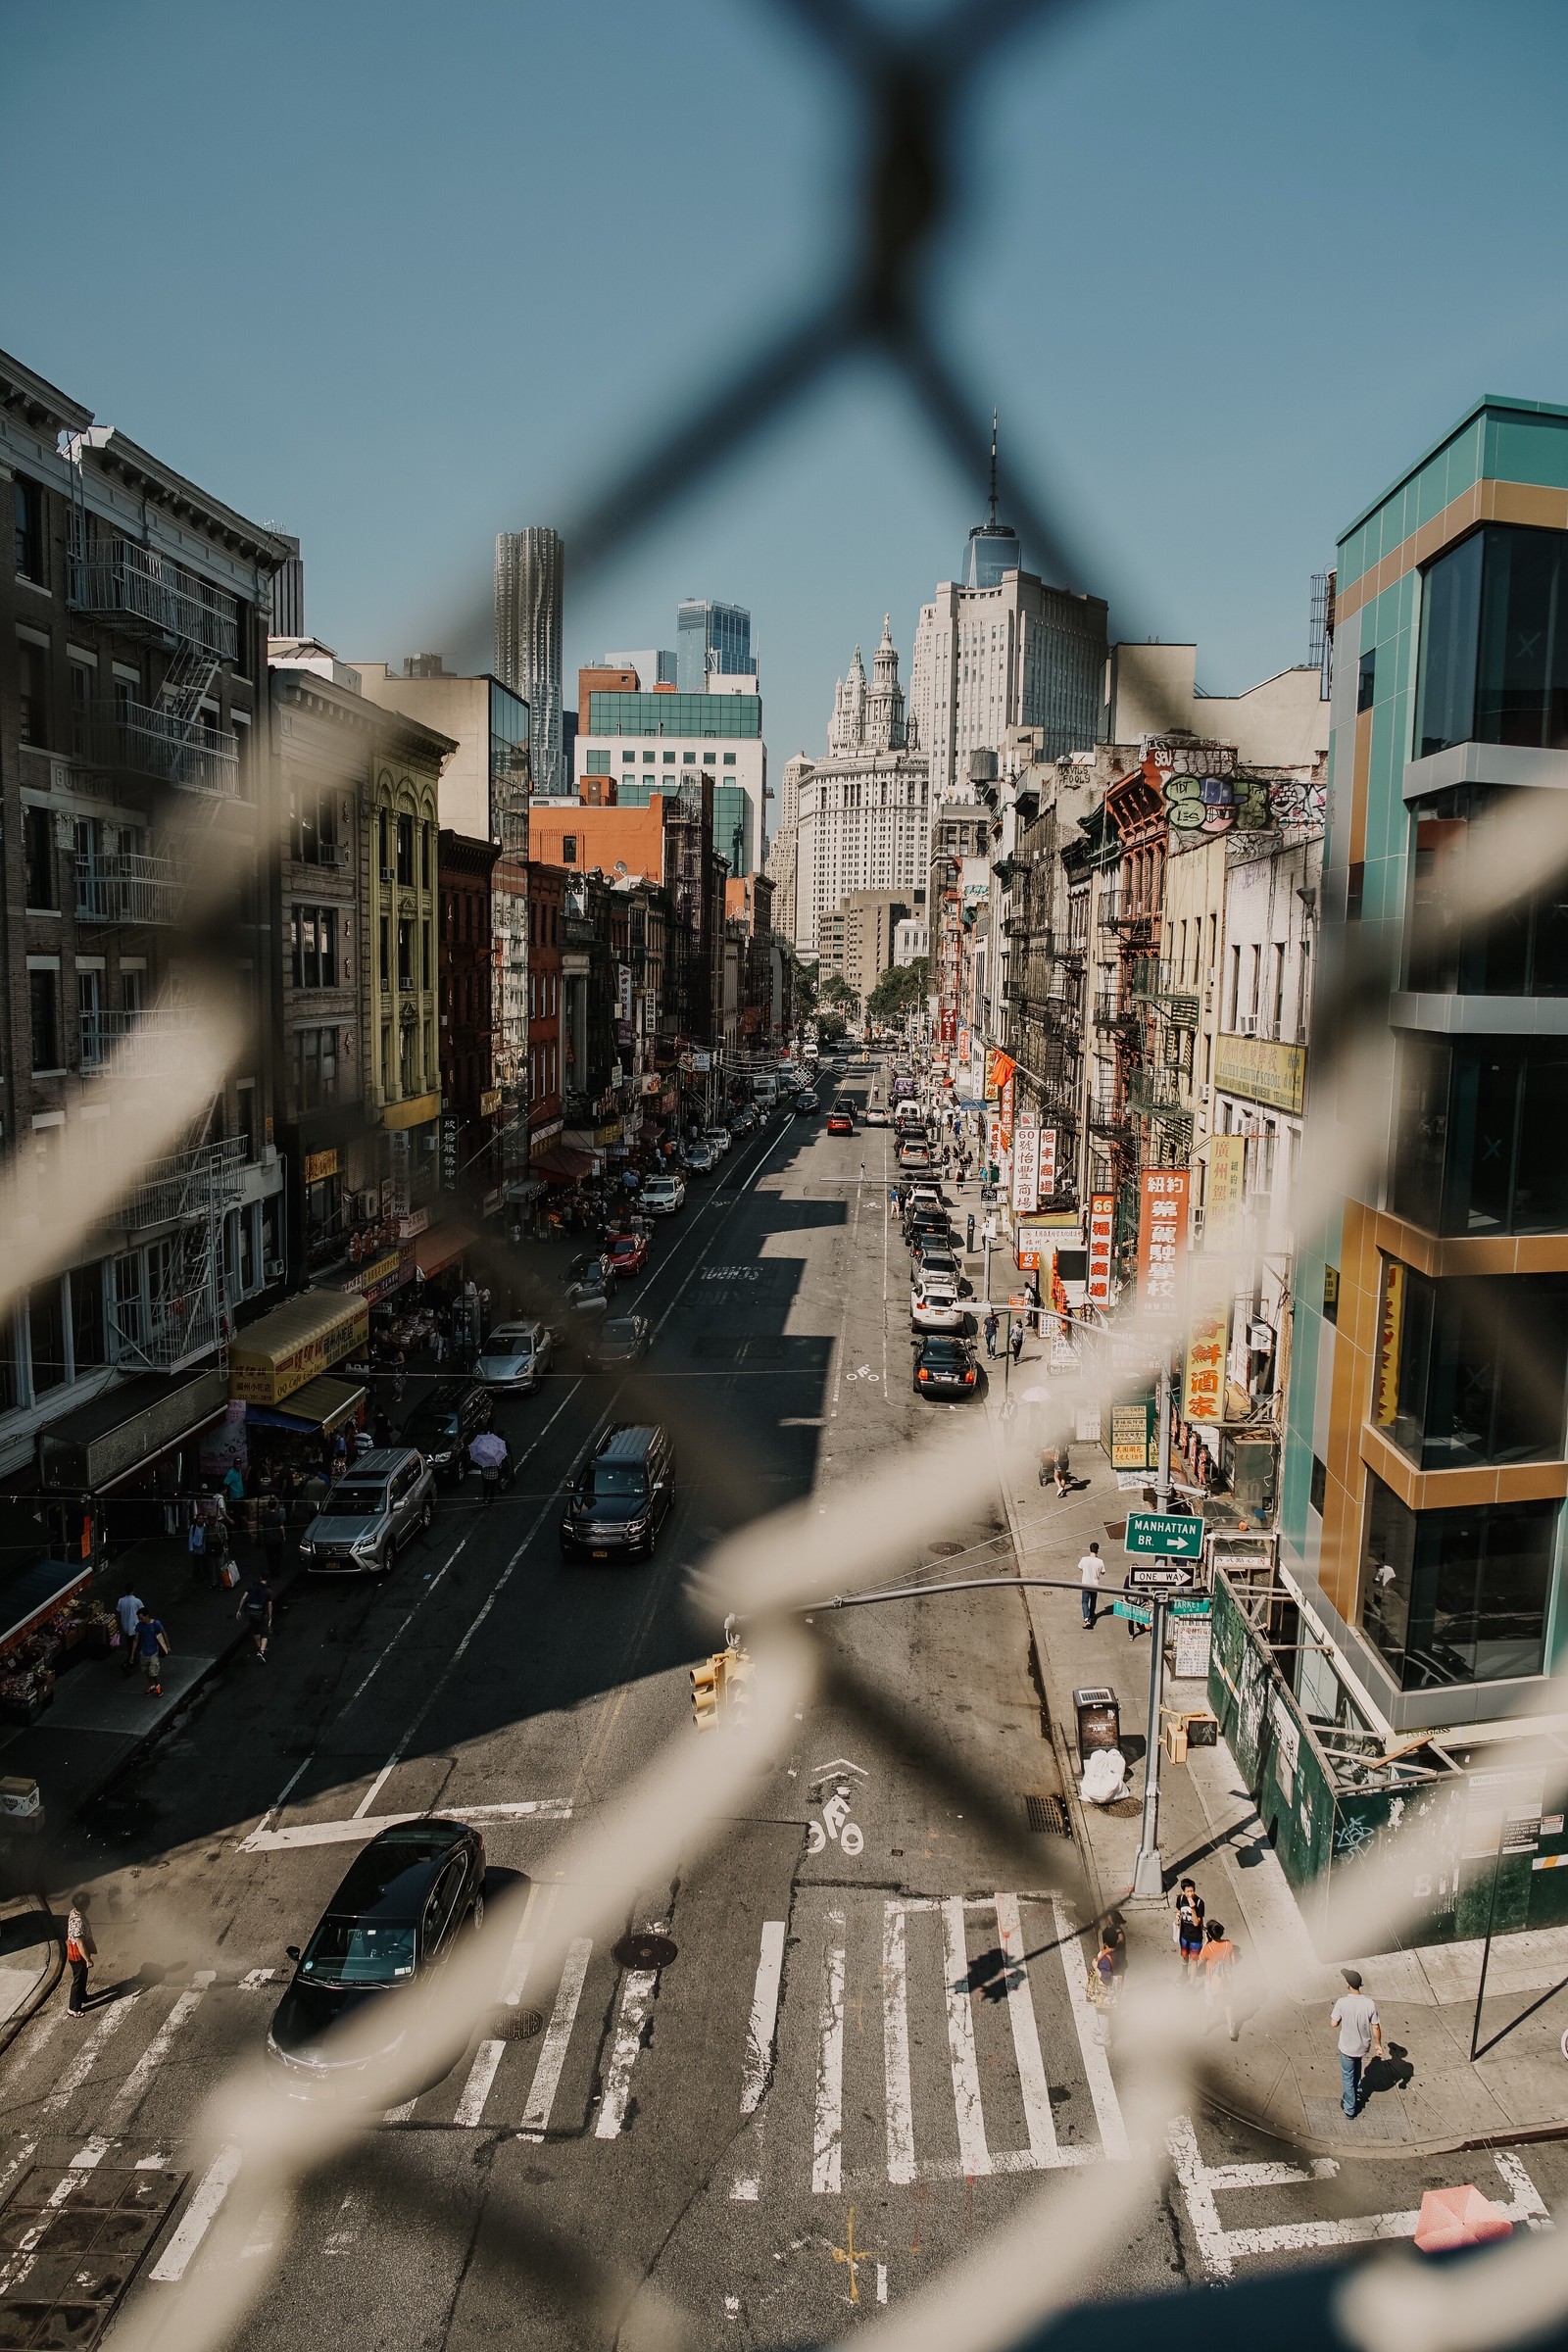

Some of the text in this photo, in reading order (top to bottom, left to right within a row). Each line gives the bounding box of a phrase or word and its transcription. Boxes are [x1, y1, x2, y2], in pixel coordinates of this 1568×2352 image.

[1147, 1177, 1183, 1193] 紐約
[1093, 1200, 1112, 1212] 66
[1147, 1200, 1178, 1298] 第一駕駛學校
[1134, 1520, 1197, 1535] MANHATTAN
[1138, 1535, 1154, 1546] BR.
[1122, 1604, 1151, 1619] BROADWAY
